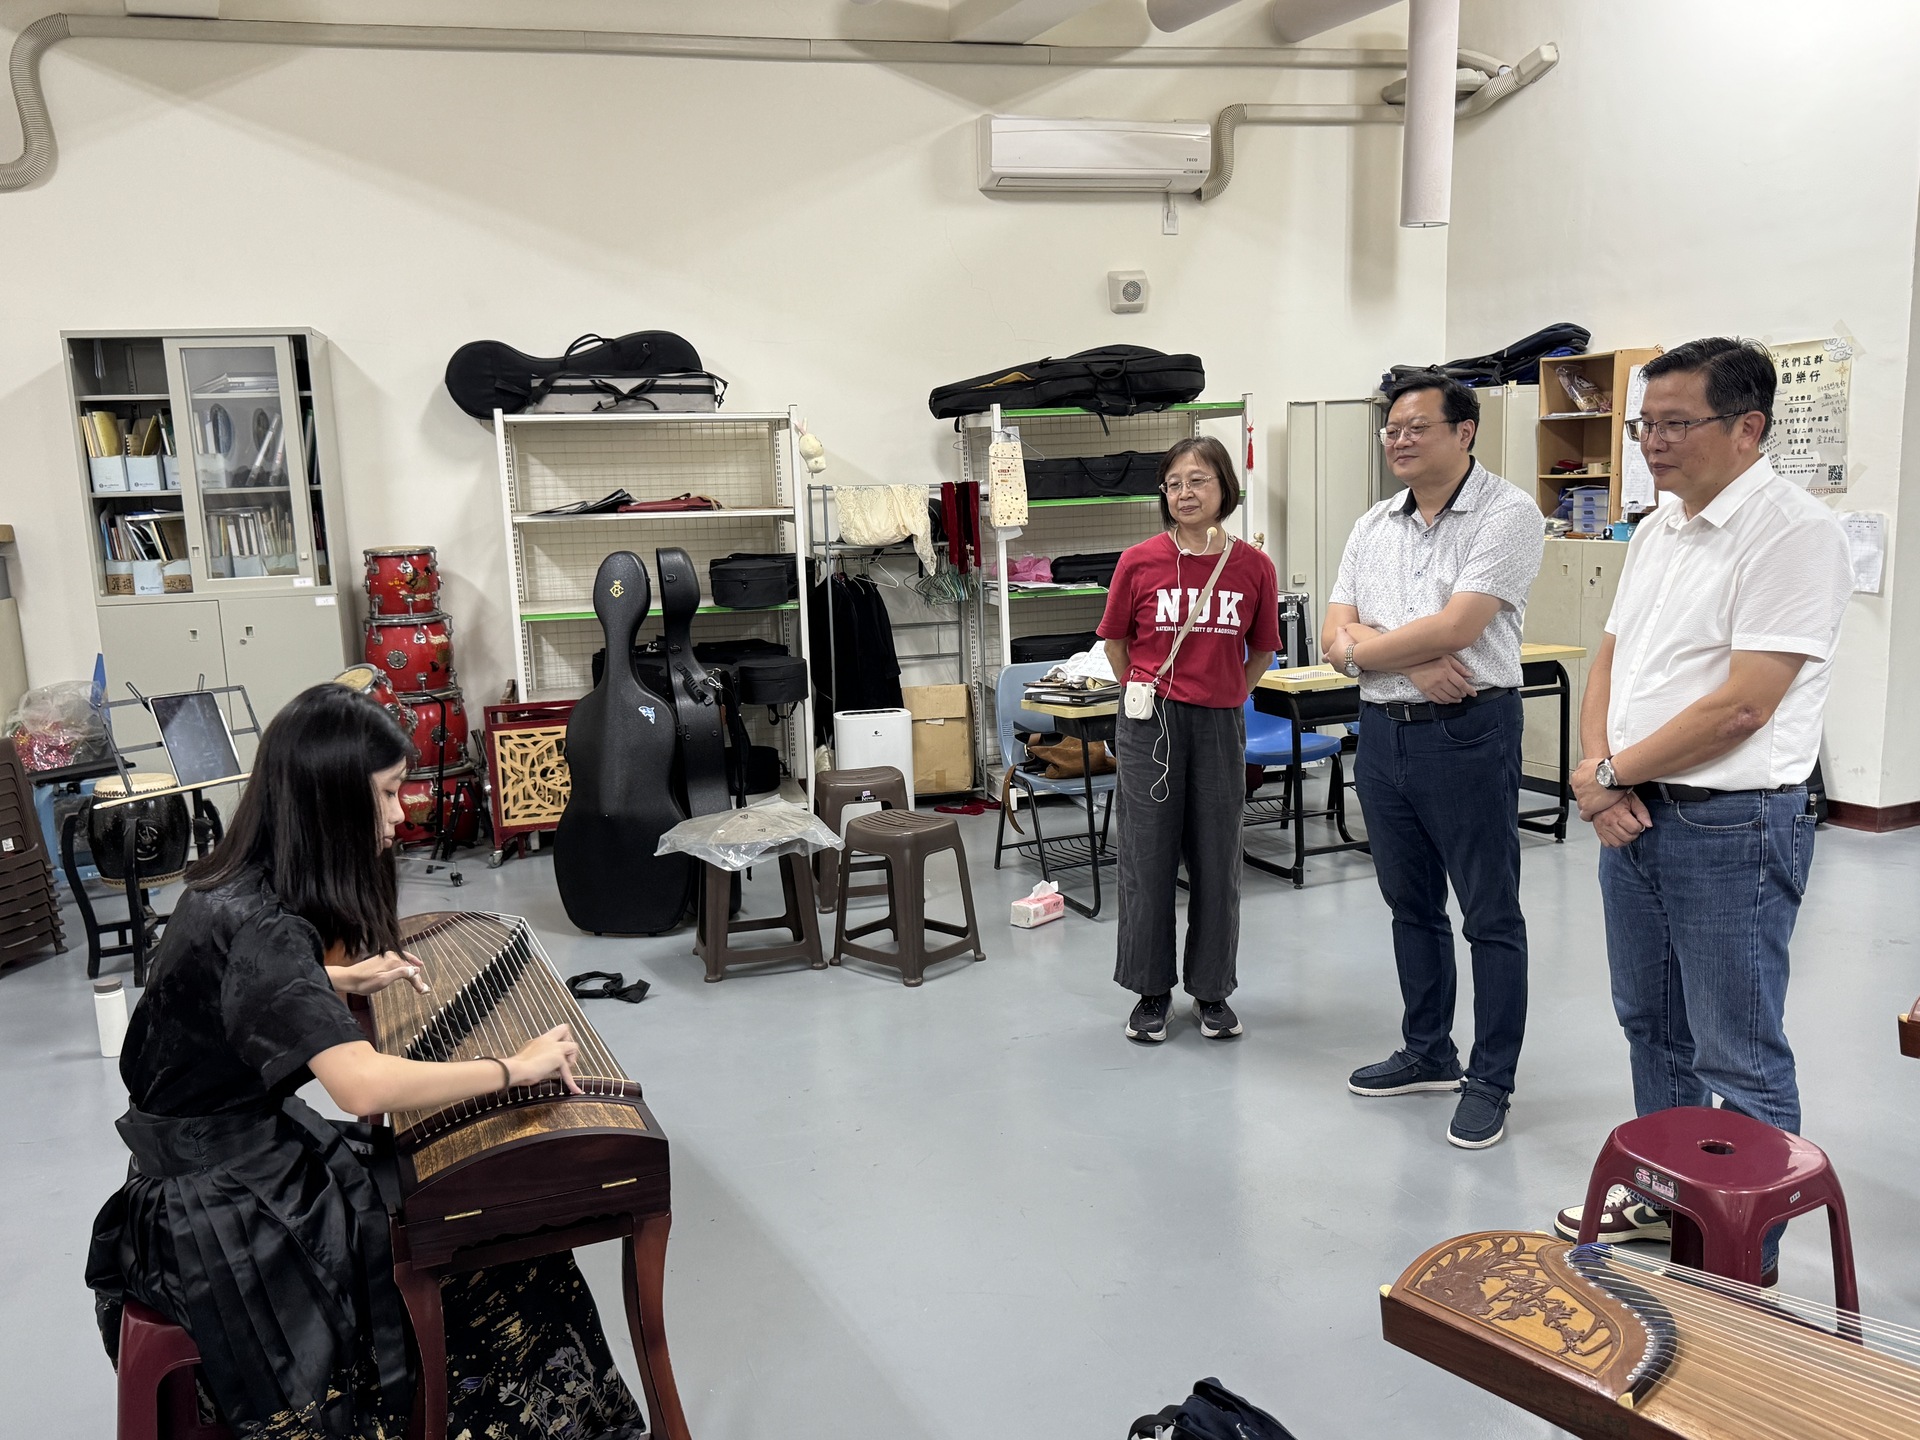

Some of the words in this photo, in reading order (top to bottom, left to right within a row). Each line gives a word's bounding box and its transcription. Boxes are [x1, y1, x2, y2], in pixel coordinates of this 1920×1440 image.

[1781, 354, 1824, 368] 我們這群
[1781, 370, 1821, 384] 國樂仔
[1155, 588, 1244, 626] NUK
